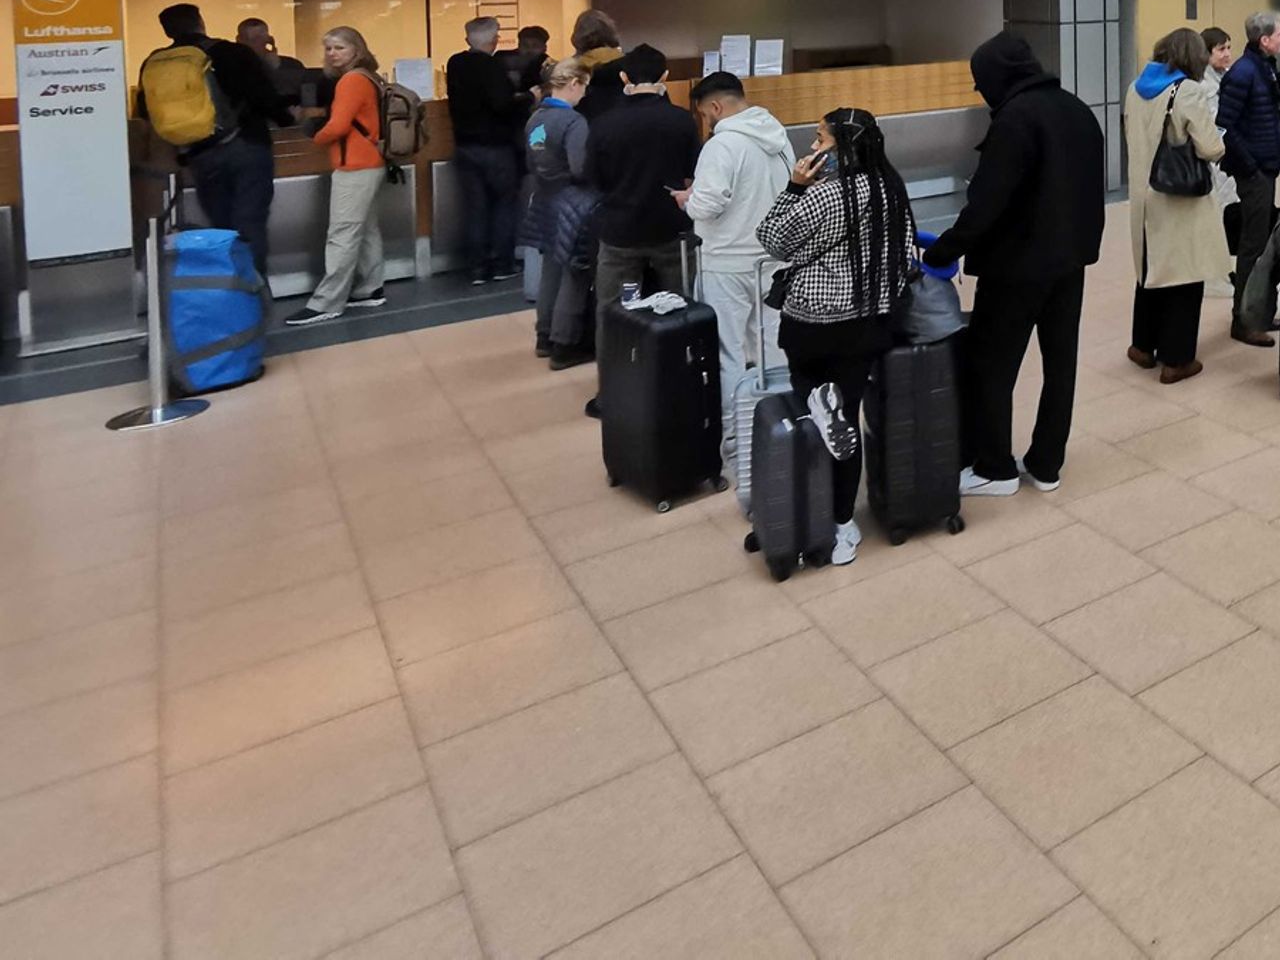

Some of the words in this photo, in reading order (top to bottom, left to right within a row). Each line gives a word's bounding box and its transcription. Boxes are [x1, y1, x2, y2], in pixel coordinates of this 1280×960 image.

[24, 25, 114, 37] Lufthansa
[27, 48, 89, 59] Austrian
[61, 83, 107, 94] SWISS
[29, 106, 95, 118] Service
